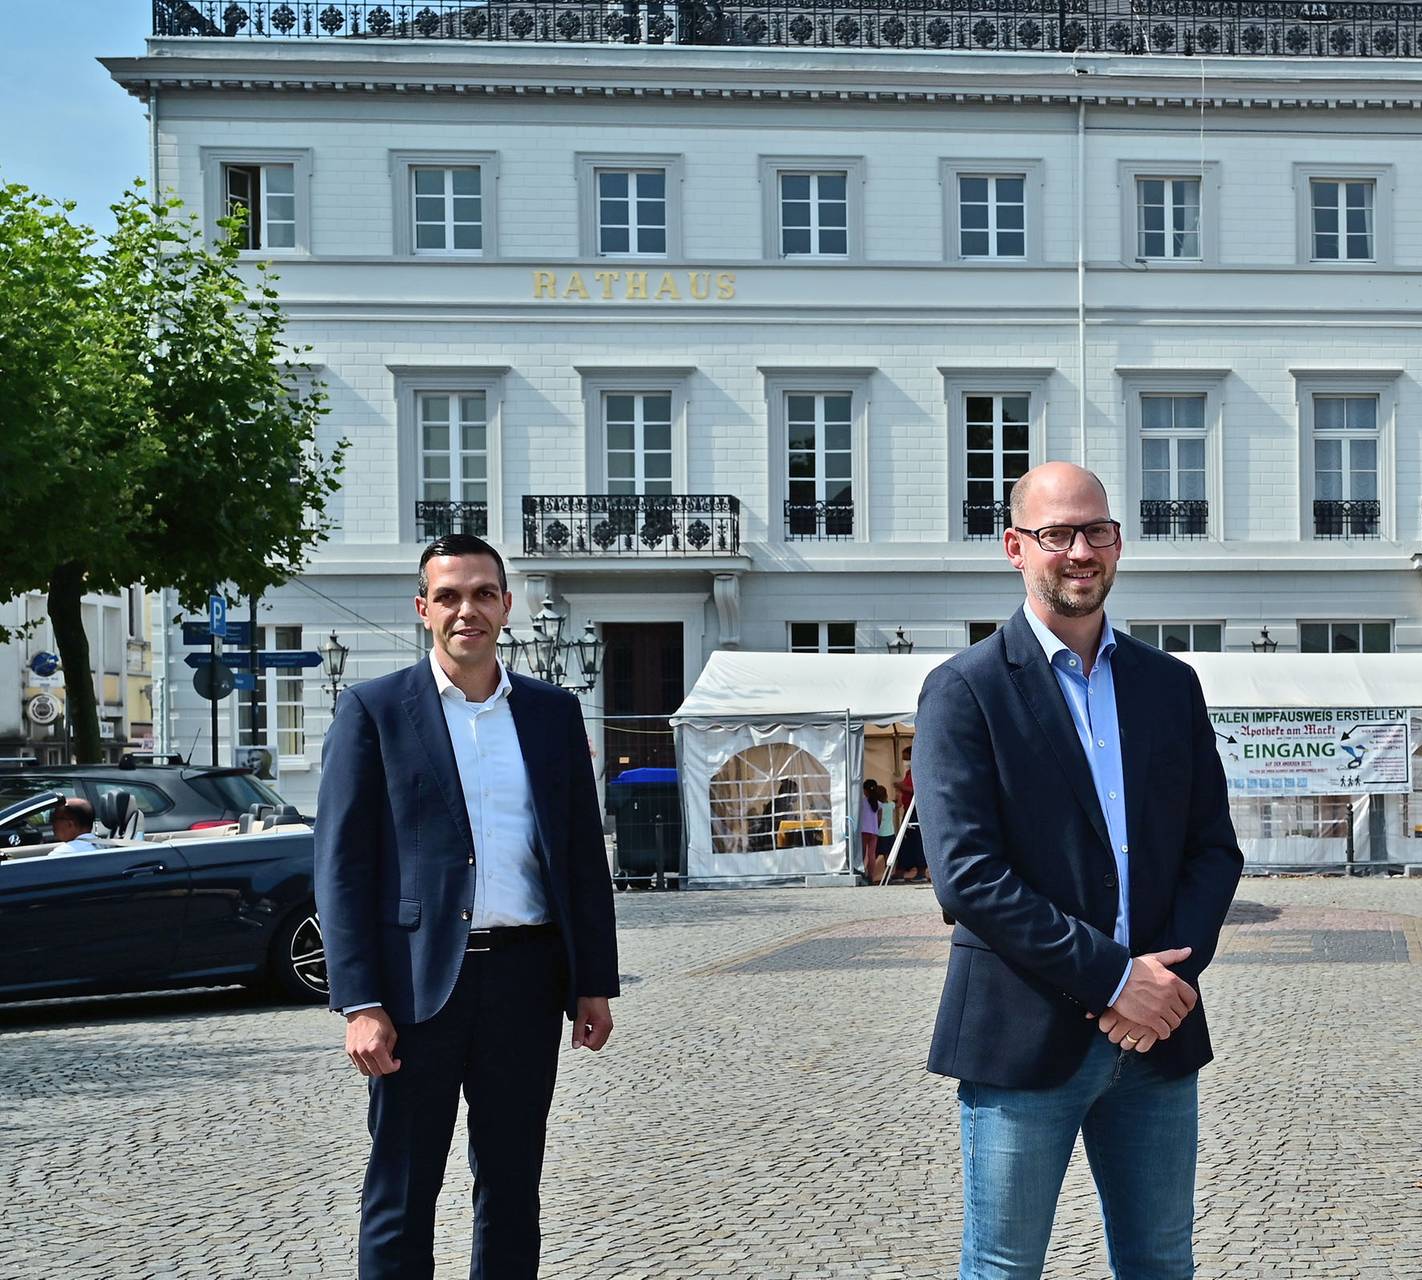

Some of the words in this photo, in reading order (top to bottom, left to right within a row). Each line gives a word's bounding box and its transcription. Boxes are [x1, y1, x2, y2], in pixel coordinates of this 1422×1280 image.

[533, 271, 737, 300] RATHAUS
[213, 601, 222, 629] P
[1252, 711, 1333, 723] IMPFAUSWEIS
[1241, 725, 1284, 737] Apotheke
[1244, 742, 1336, 759] EINGANG
